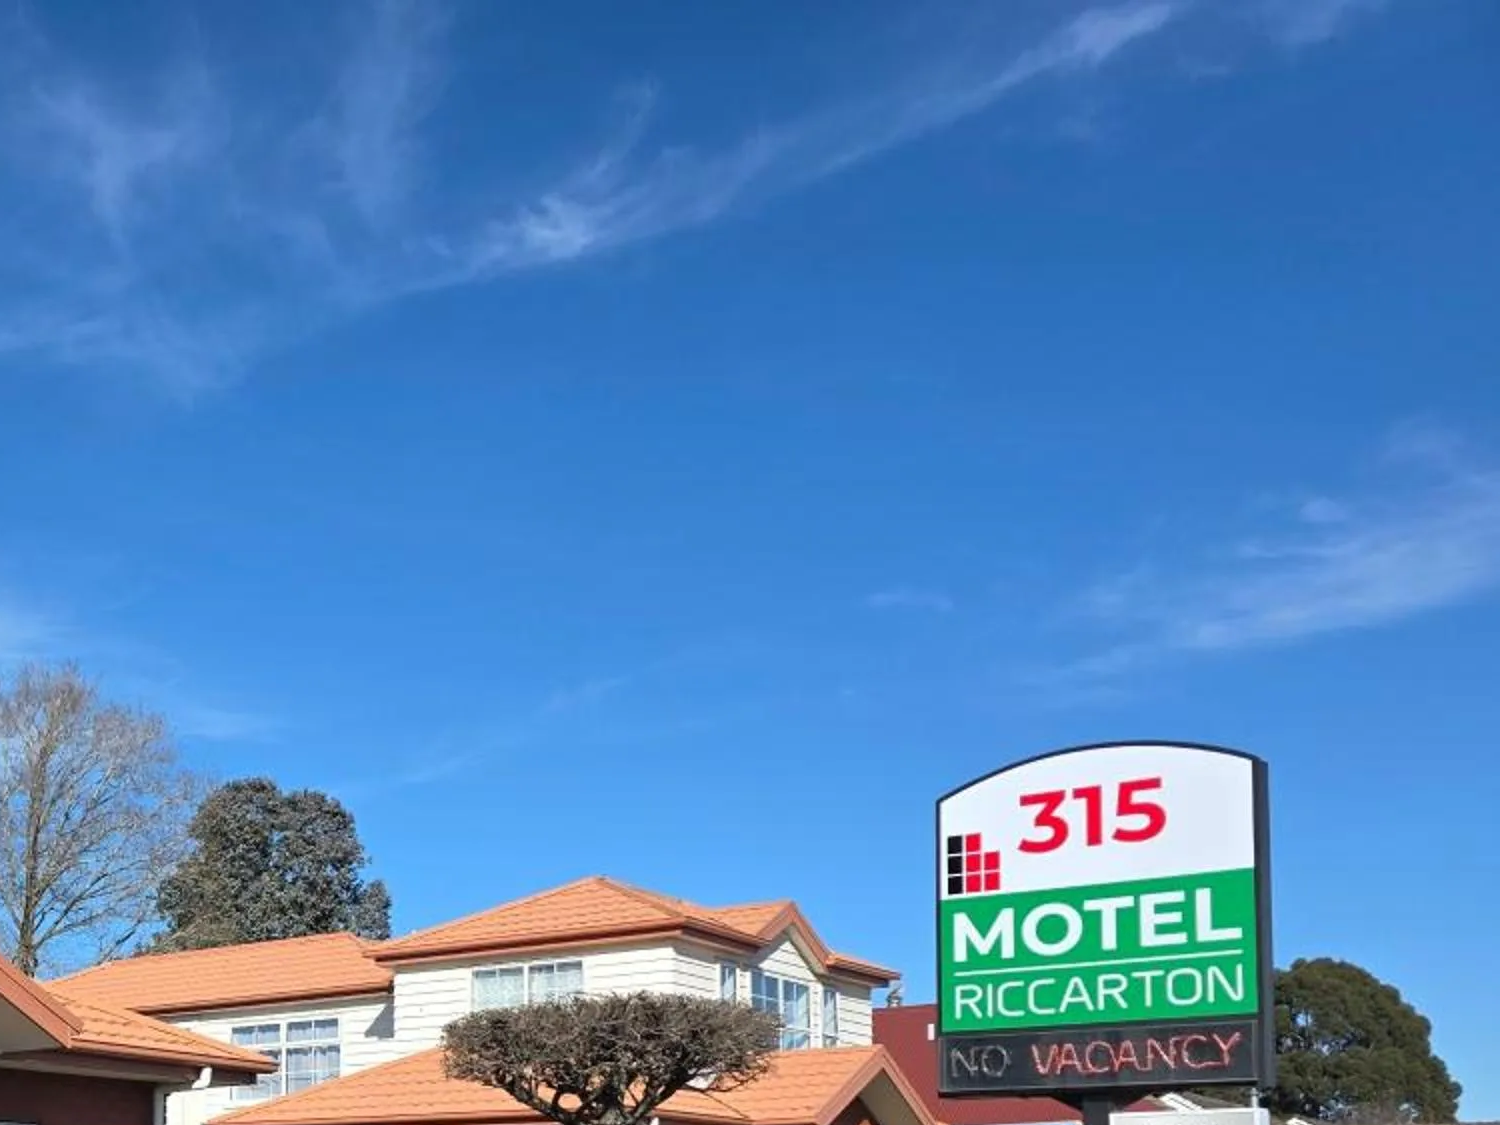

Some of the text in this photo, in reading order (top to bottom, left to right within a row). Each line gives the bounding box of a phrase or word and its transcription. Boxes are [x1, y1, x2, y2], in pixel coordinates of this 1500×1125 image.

[1018, 777, 1167, 853] 315
[953, 887, 1243, 963] MOTEL
[955, 963, 1244, 1020] RICCARTON
[951, 1031, 1242, 1078] NO VACANCY
